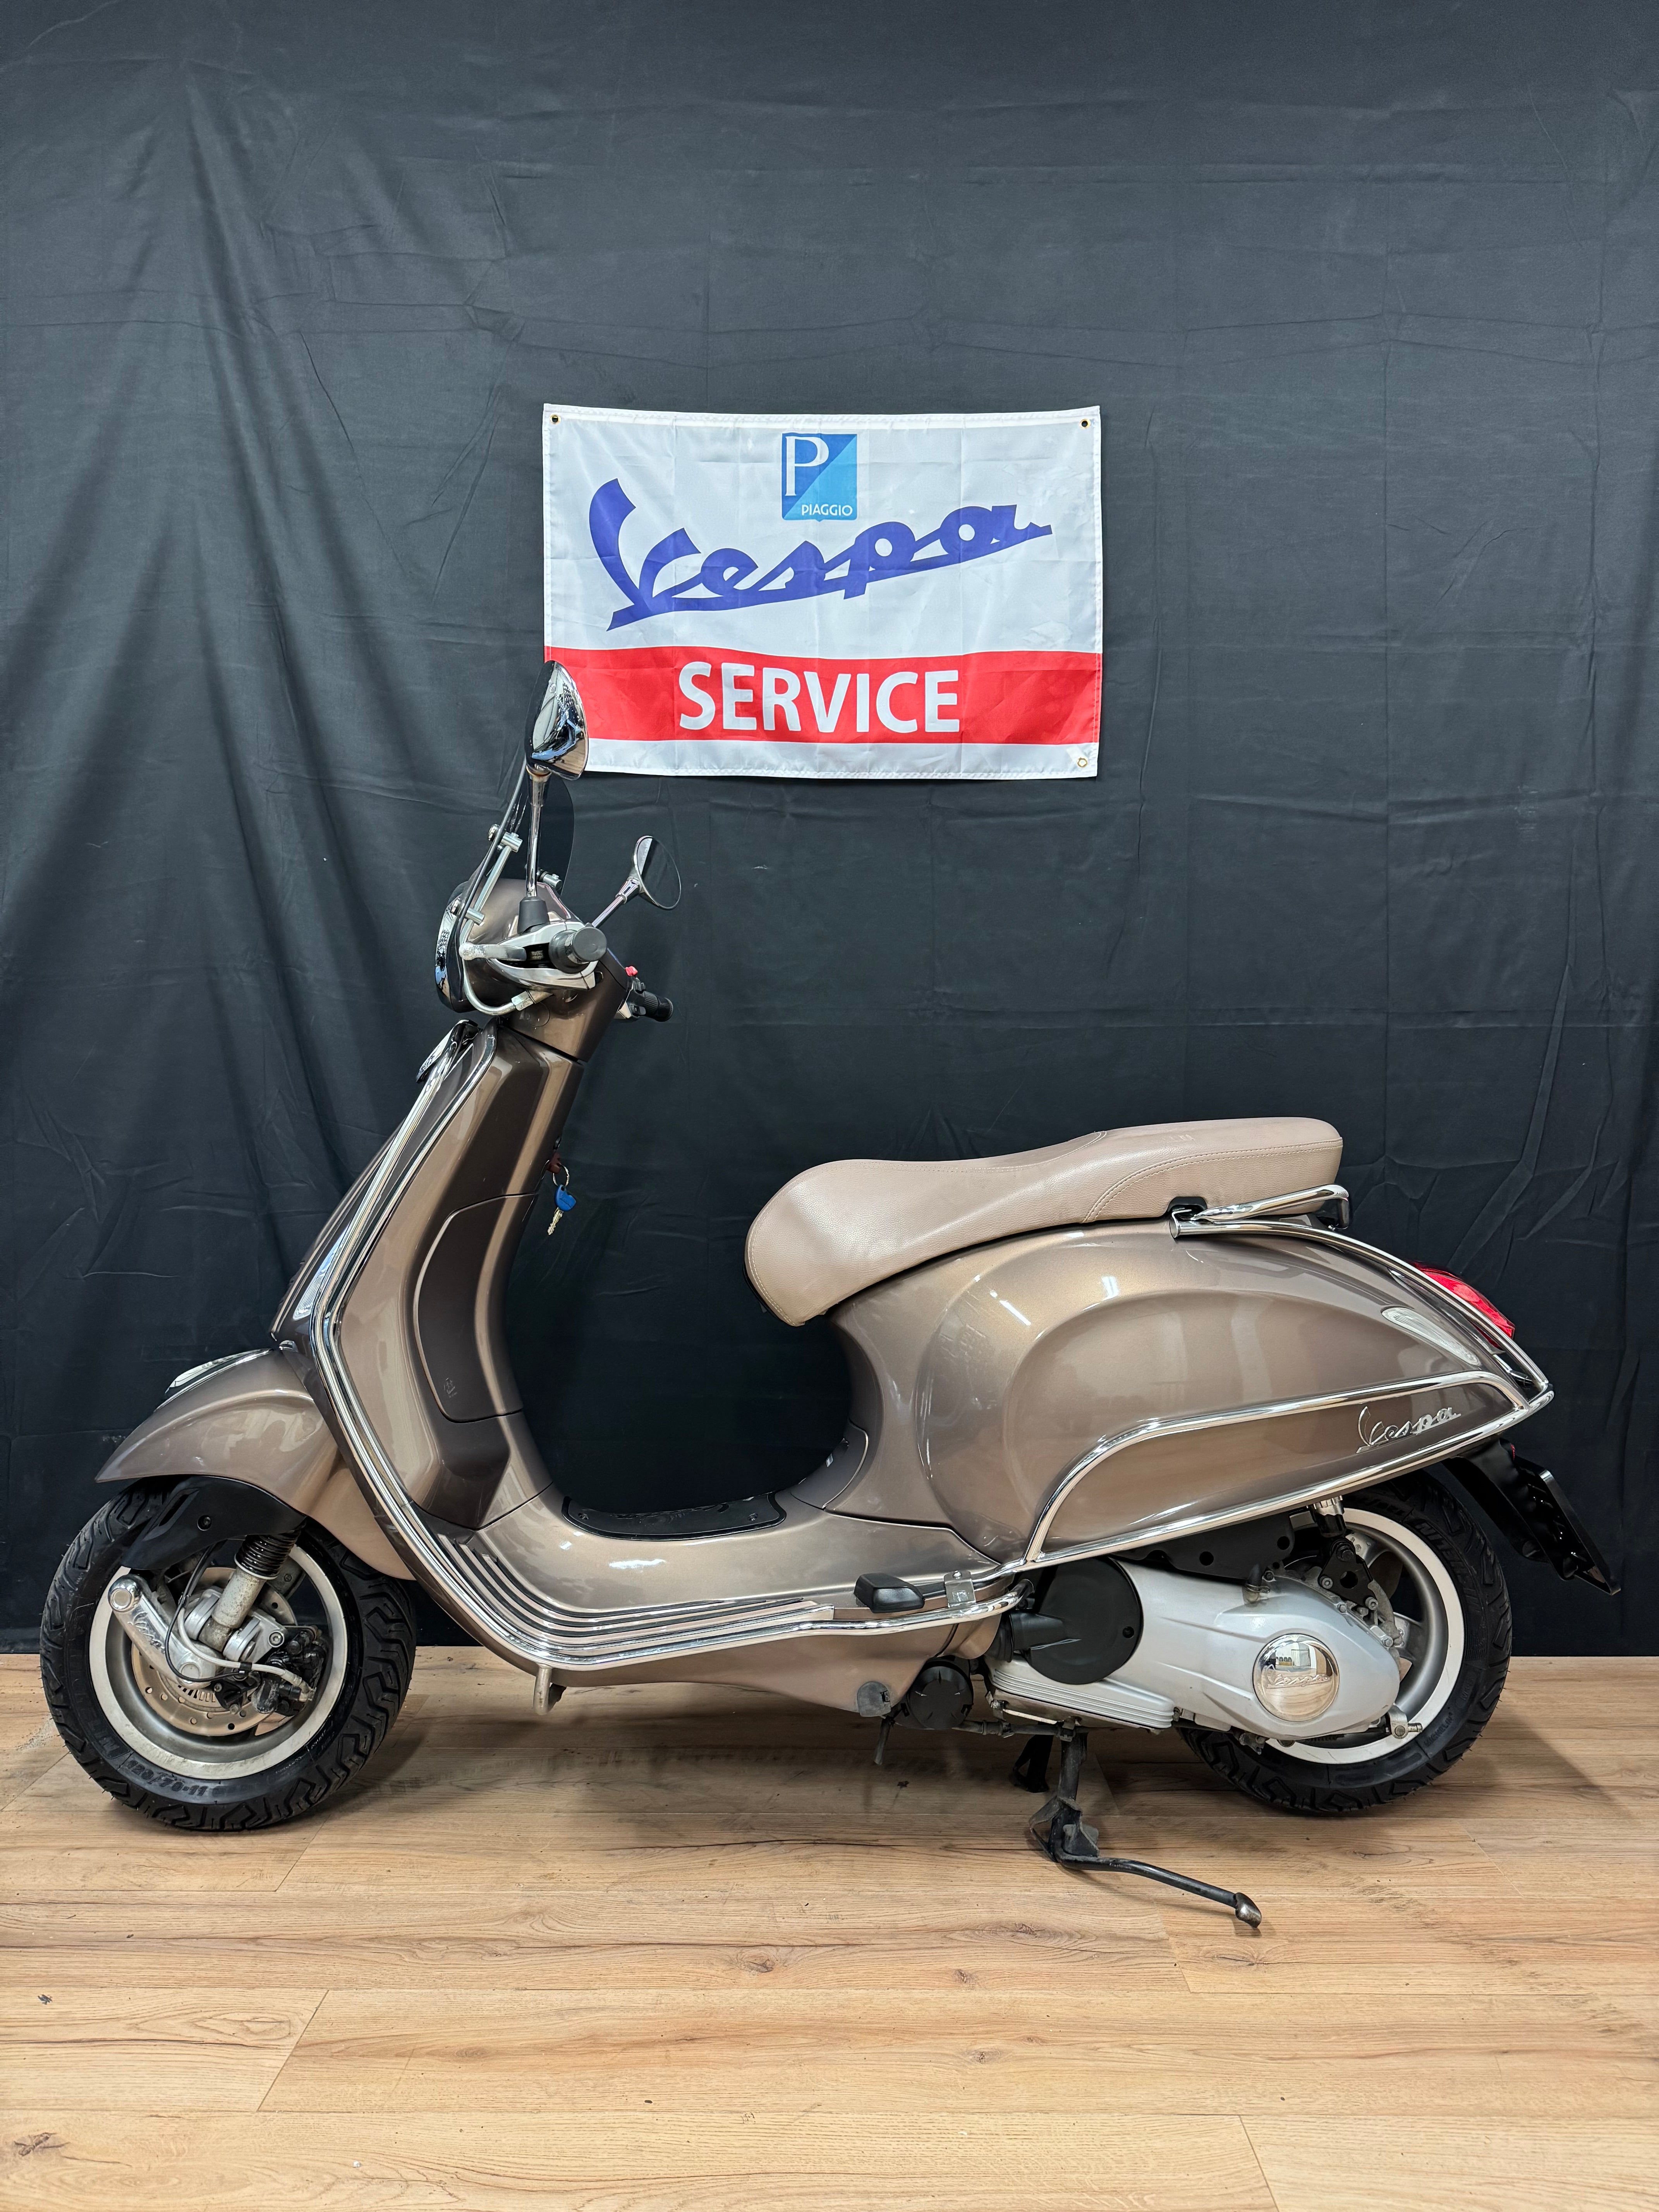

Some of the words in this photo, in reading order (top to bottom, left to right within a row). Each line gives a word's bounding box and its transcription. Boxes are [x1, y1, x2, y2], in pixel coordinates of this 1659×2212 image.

[785, 436, 829, 496] P
[802, 504, 852, 516] PIAGGIO
[589, 478, 1053, 631] Vespa
[678, 661, 960, 733] SERVICE
[1357, 1406, 1462, 1453] Vespa
[1266, 1664, 1330, 1689] Vespa
